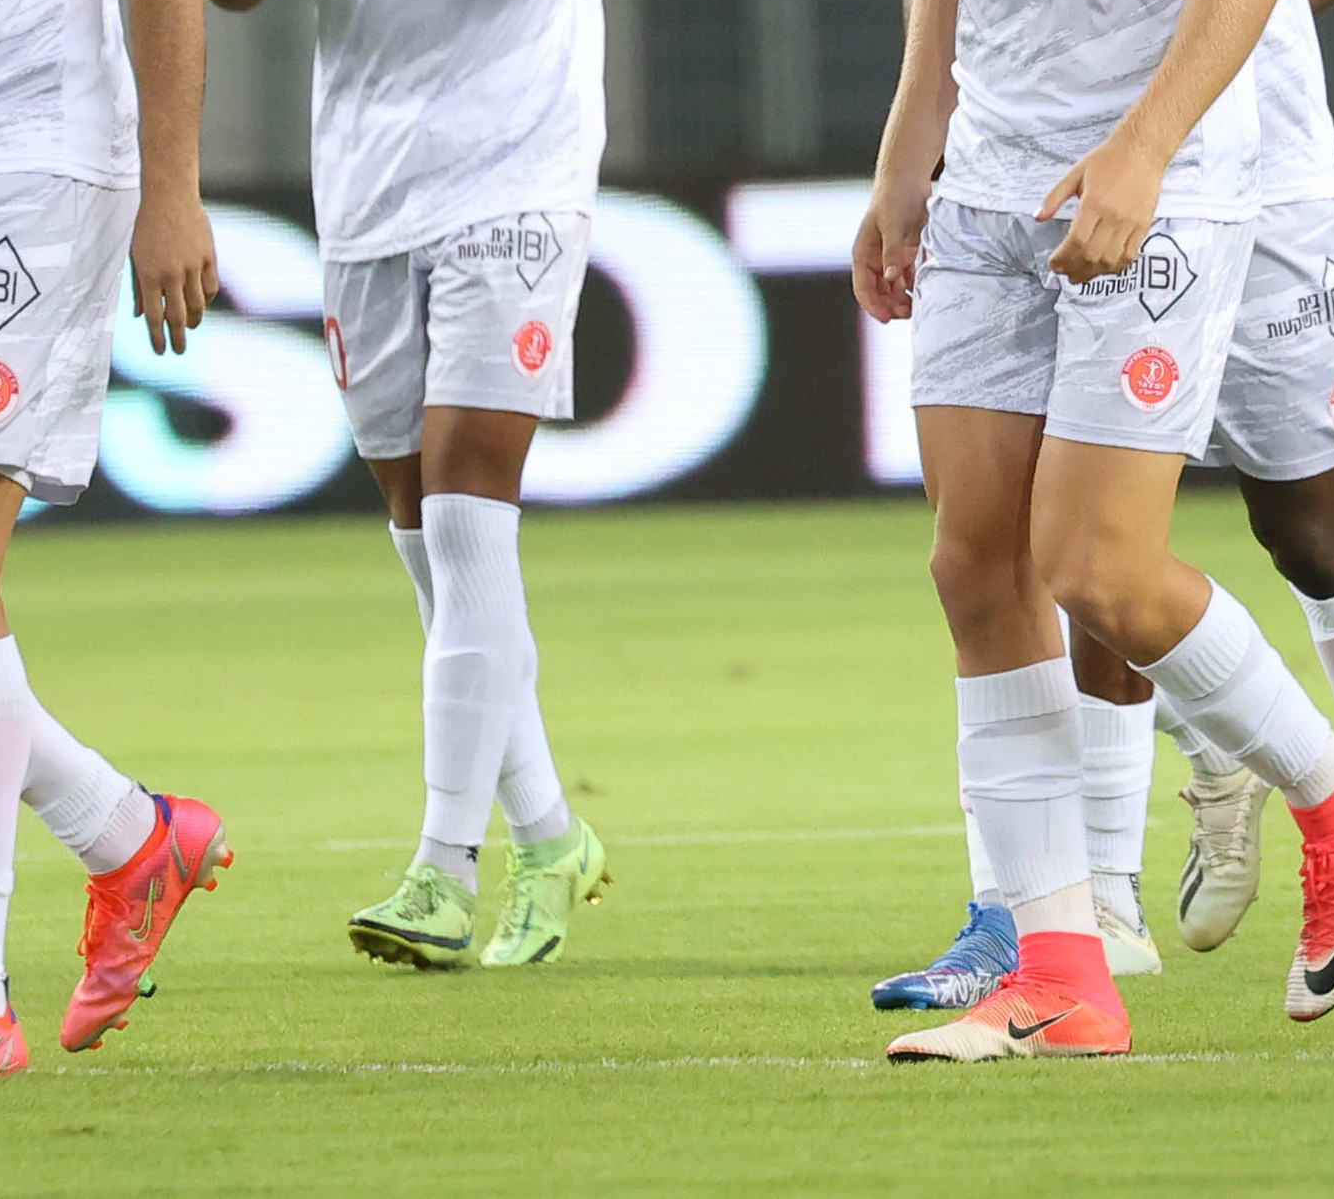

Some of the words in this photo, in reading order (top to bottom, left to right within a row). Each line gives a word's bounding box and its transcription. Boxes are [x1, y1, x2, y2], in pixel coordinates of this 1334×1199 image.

[1140, 254, 1178, 291] IBI
[1297, 293, 1321, 314] בית
[1267, 309, 1323, 339] השקעות
